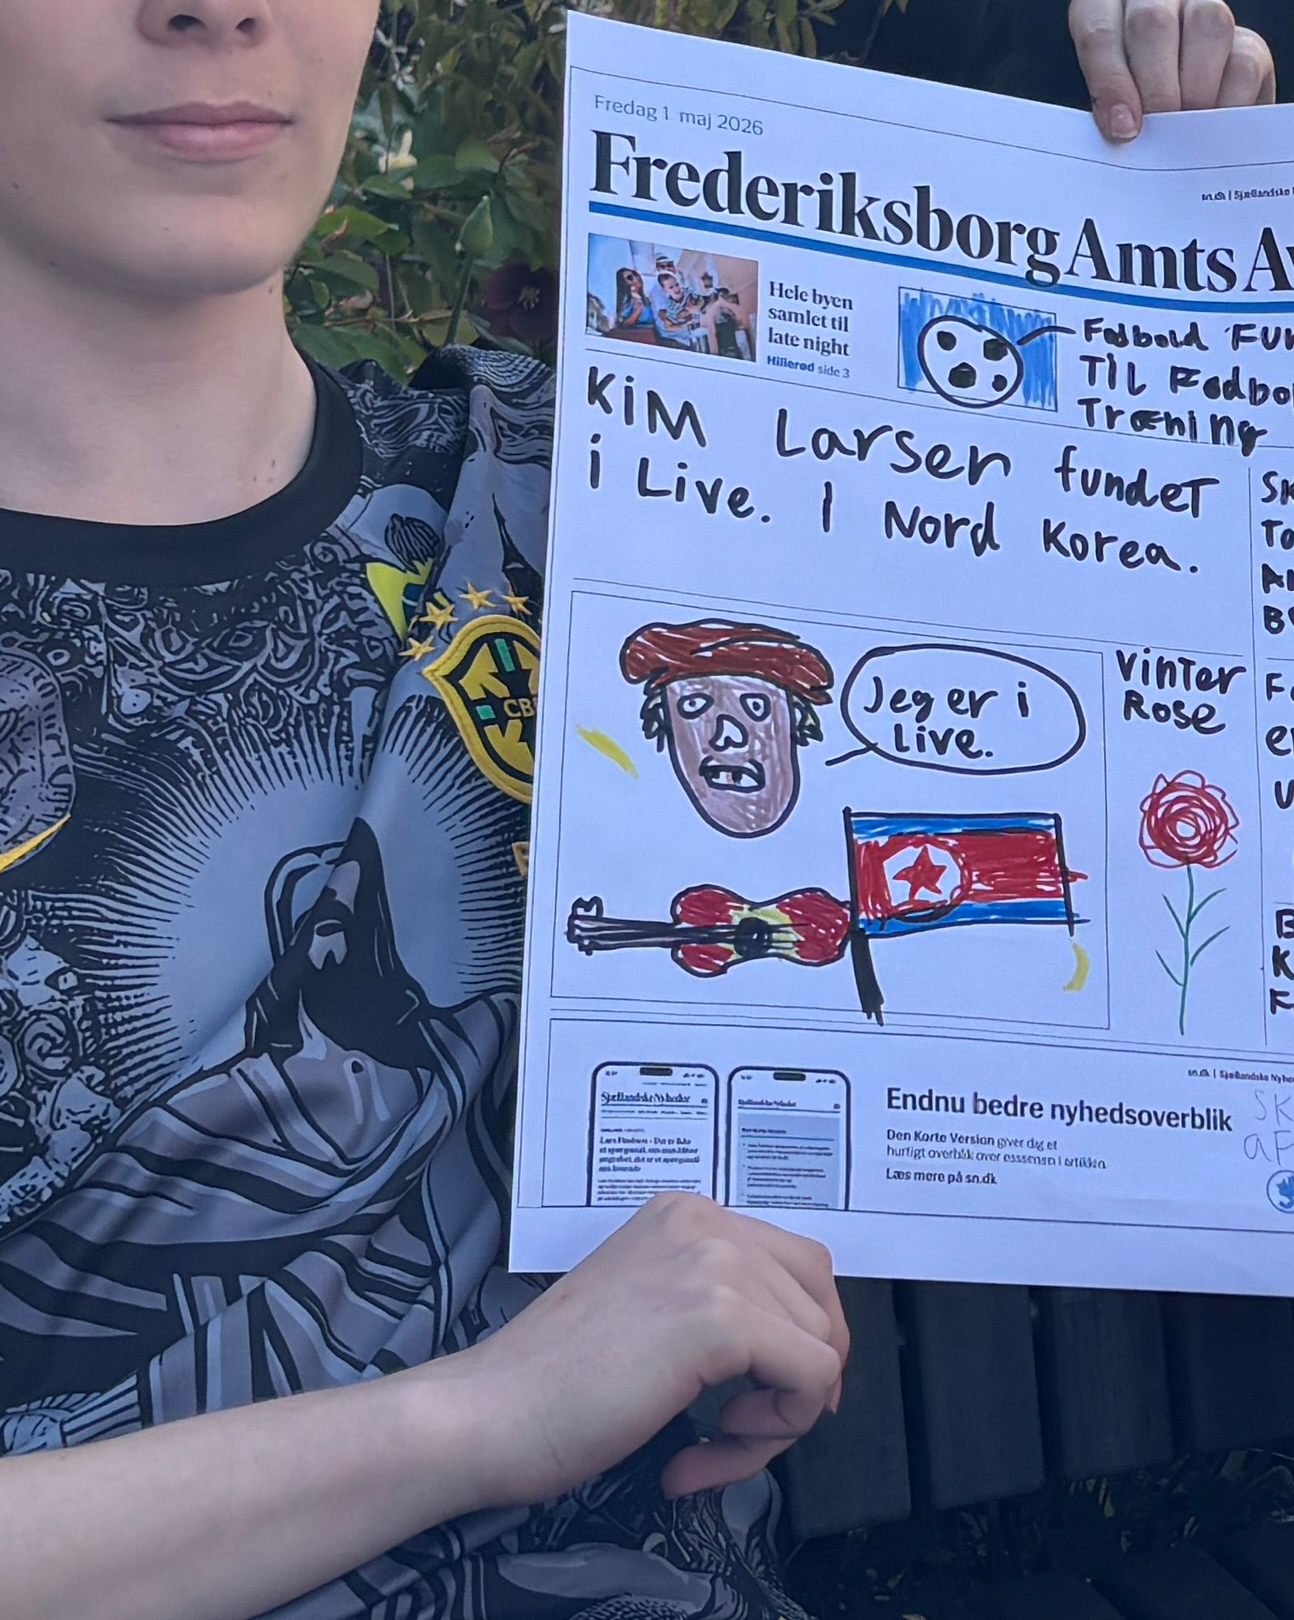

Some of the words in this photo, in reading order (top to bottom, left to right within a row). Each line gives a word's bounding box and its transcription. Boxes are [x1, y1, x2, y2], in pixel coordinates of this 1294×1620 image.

[594, 94, 657, 122] Fredag
[679, 111, 712, 130] maj
[716, 115, 763, 136] 2026
[590, 129, 1061, 288] Frederiksborg
[1068, 217, 1237, 293] Amts
[769, 281, 808, 302] Hele
[812, 288, 853, 310] byen
[768, 306, 827, 329] samlet
[831, 316, 849, 332] til
[768, 327, 800, 347] late
[803, 336, 850, 357] night
[817, 364, 841, 378] side
[842, 369, 850, 379] 3
[775, 408, 1011, 484] Larsen
[884, 500, 1001, 557] Nord
[503, 698, 540, 720] CB
[863, 676, 934, 724] Jeg
[946, 687, 999, 720] er
[1016, 680, 1031, 719] i
[1123, 689, 1227, 736] Rose
[887, 1087, 966, 1115] Endnu
[972, 1091, 1044, 1119] bedre
[1050, 1100, 1234, 1132] nyhedsoverblik
[886, 1129, 911, 1142] Den
[950, 1133, 996, 1147] Version
[886, 1145, 926, 1161] hurtigt
[886, 1168, 912, 1181] Læs
[914, 1170, 946, 1182] mere
[947, 1170, 963, 1185] på
[964, 1172, 998, 1185] sn.dk
